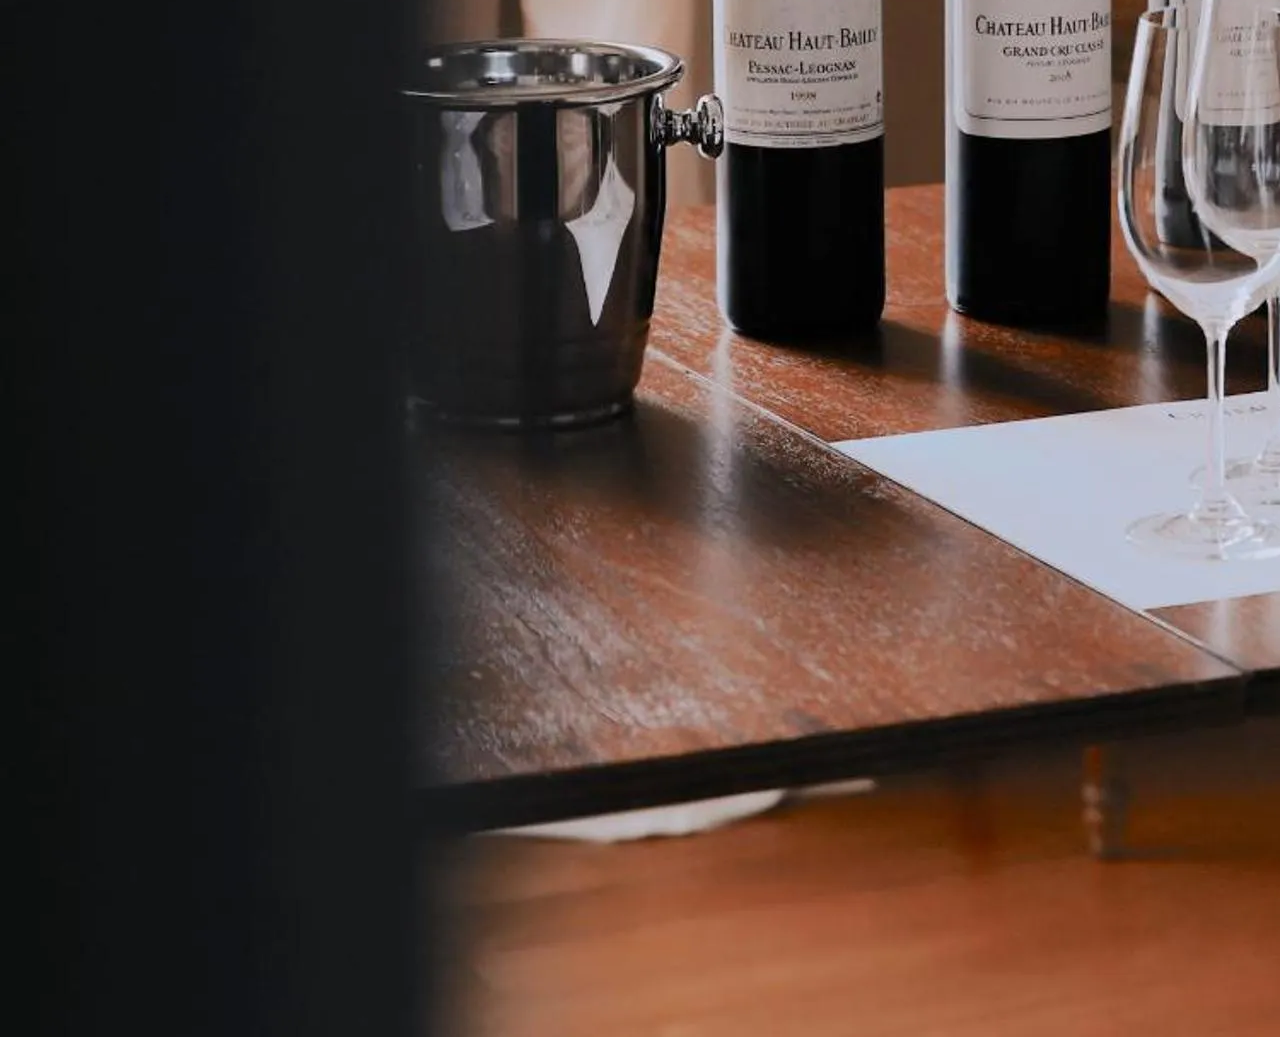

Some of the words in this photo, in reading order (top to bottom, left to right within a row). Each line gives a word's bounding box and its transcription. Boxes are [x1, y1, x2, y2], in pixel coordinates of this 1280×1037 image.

[975, 13, 1046, 37] CHATEAU
[729, 30, 785, 51] HATEAU
[1002, 45, 1048, 58] GRAND
